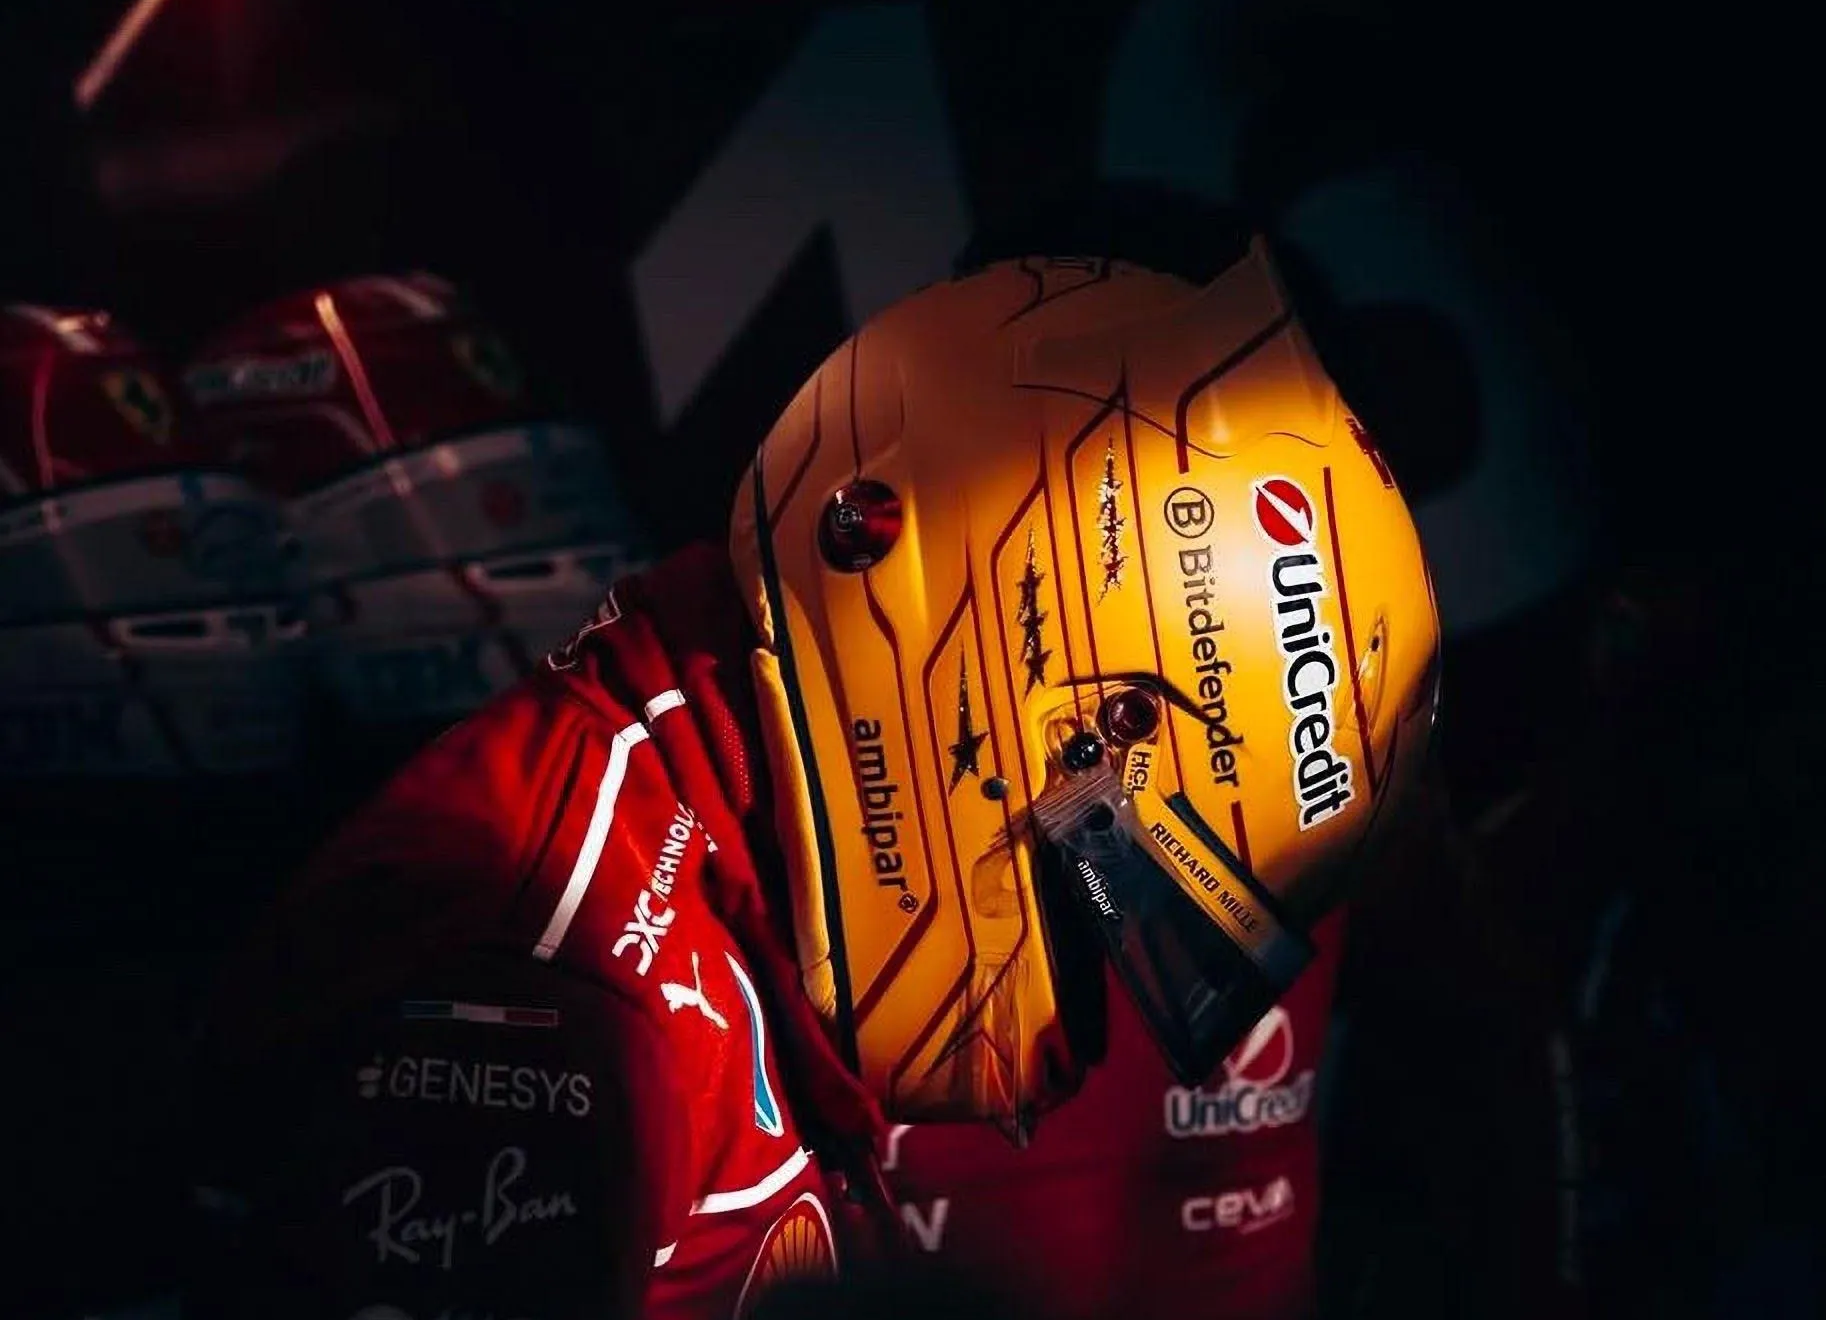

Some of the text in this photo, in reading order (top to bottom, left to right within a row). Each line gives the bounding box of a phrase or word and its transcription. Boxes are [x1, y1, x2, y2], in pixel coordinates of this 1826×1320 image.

[1179, 546, 1245, 788] Bitdefender
[1271, 553, 1350, 826] UniCredit
[854, 718, 908, 890] ambipar
[1150, 822, 1219, 891] RICHARD
[1077, 859, 1118, 917] ambipar
[389, 1057, 594, 1118] GENESYS
[342, 1146, 578, 1268] Ray-Ban
